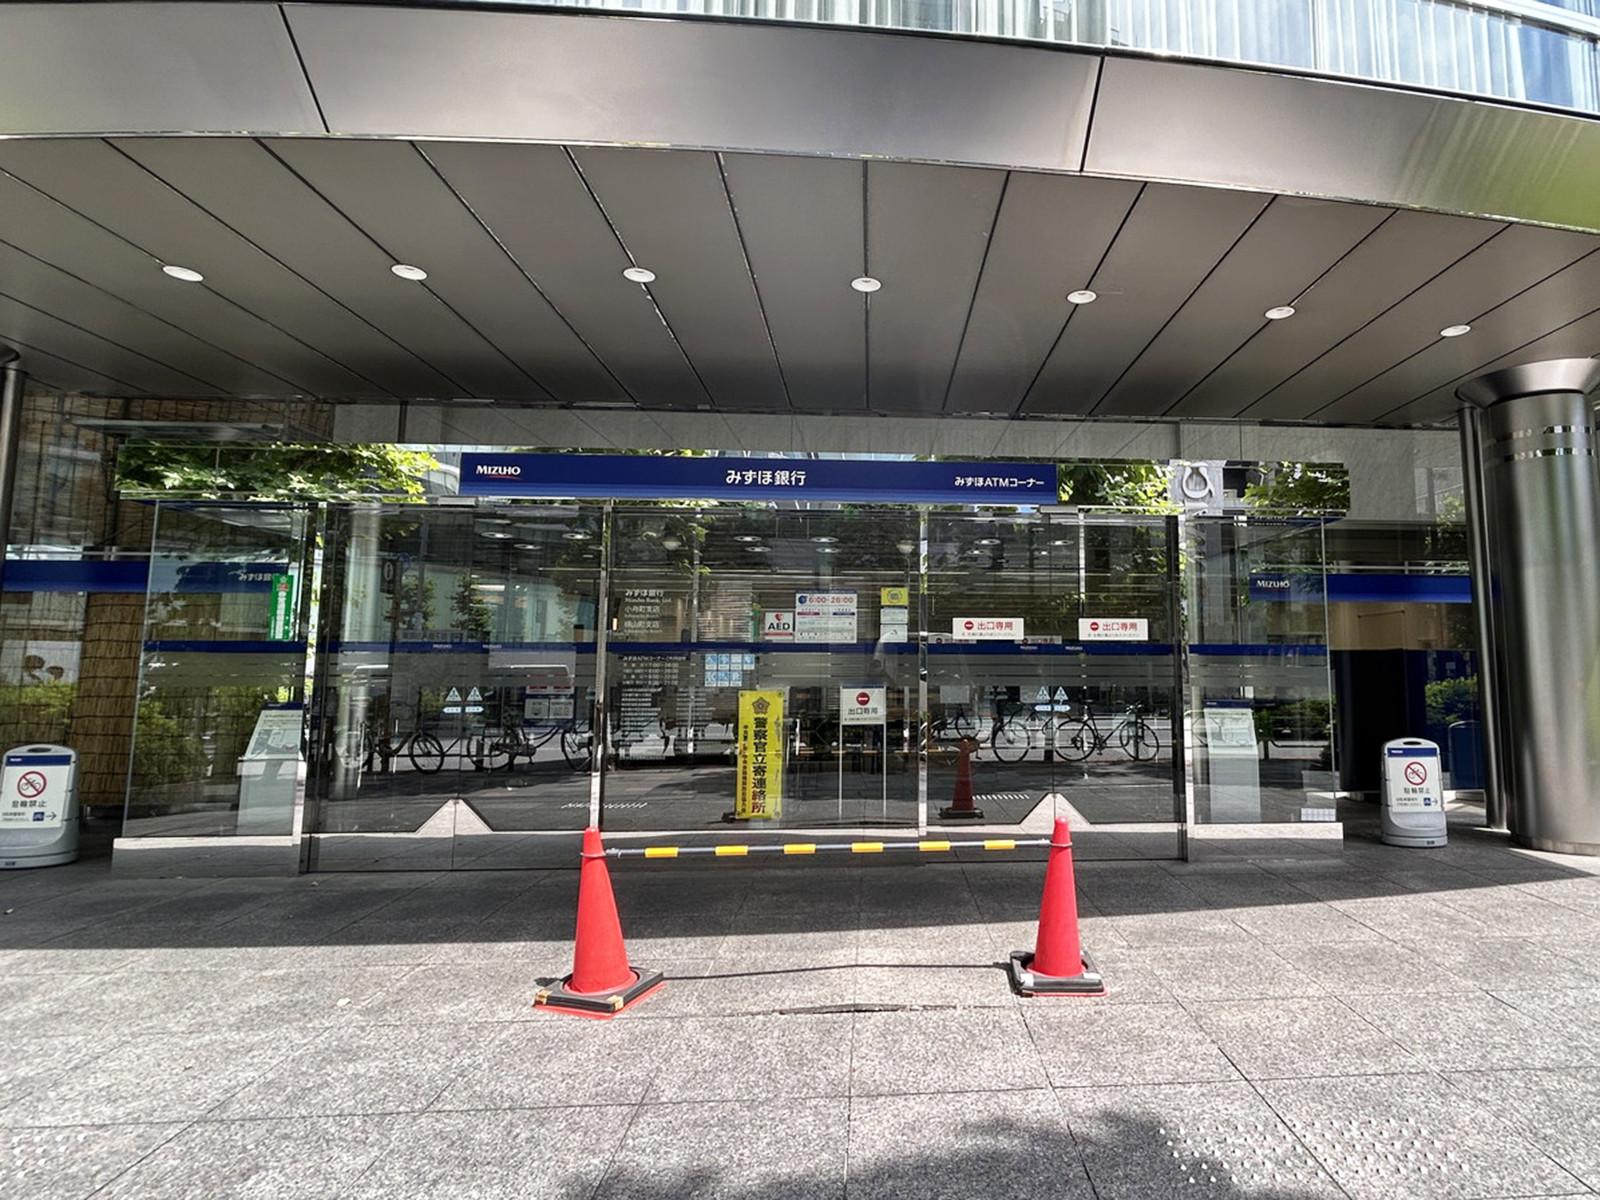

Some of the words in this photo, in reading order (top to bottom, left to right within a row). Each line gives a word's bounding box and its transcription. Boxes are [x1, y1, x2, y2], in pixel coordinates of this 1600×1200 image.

[476, 465, 521, 476] MIZUHO
[725, 469, 806, 486] みずほ銀行
[954, 476, 1045, 487] みずほATMコーナー
[1256, 580, 1290, 588] MIZUHO
[768, 622, 790, 631] AED
[977, 621, 1013, 631] 出口専用
[1102, 622, 1138, 631] 出口専用
[848, 707, 878, 715] 出口専用
[752, 717, 768, 814] 警察官立寄連絡所
